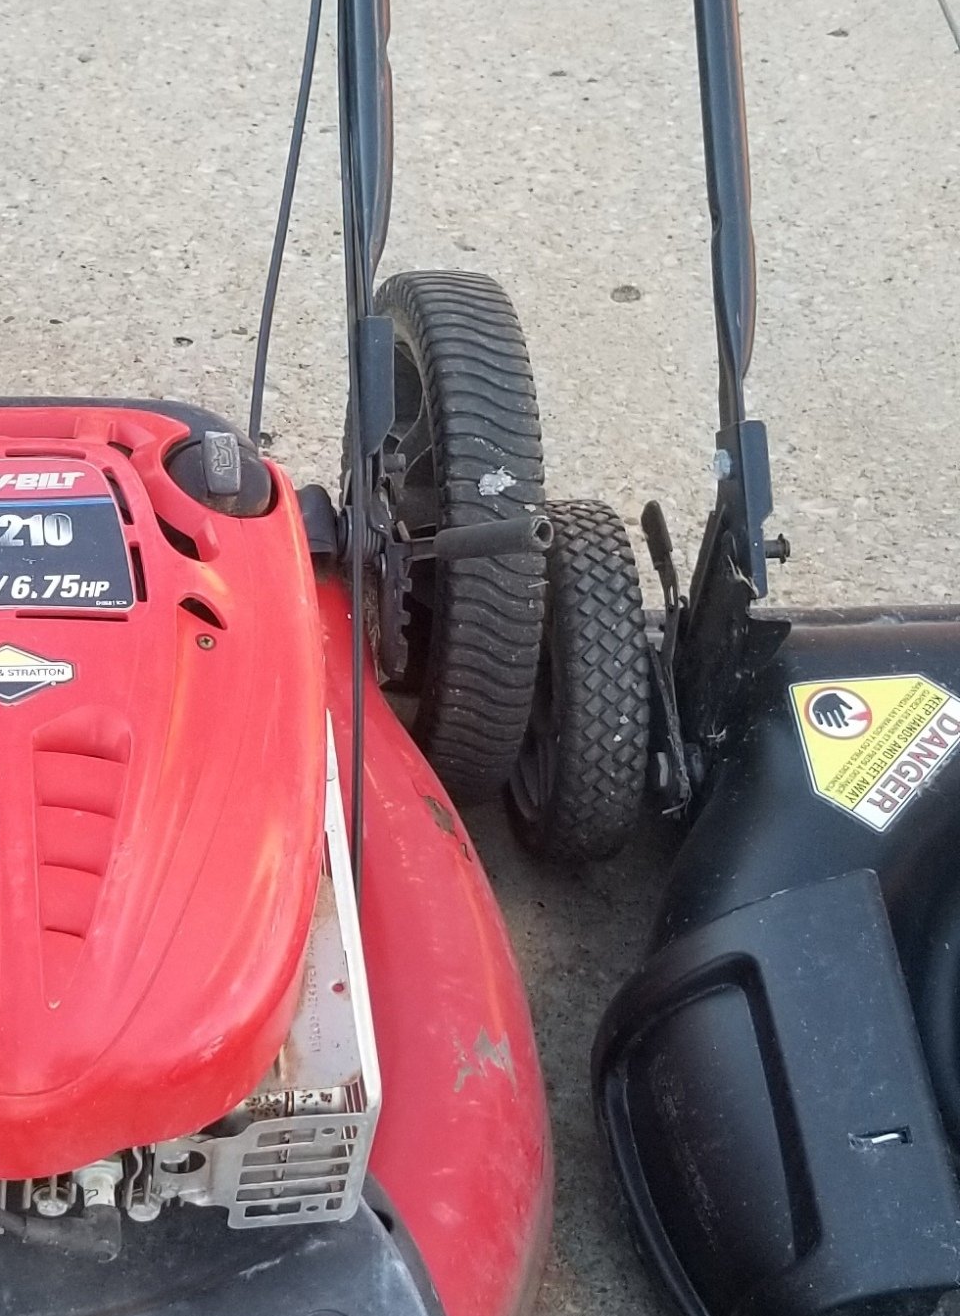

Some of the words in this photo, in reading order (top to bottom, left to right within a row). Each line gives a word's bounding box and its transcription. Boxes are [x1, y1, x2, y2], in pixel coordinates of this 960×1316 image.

[7, 668, 65, 678] STRATTON
[924, 694, 944, 717] KEEP
[897, 715, 926, 743] HANDS
[885, 741, 903, 760] AND
[866, 712, 960, 814] DANGER
[868, 758, 889, 780] FEET
[844, 778, 871, 804] AWAY
